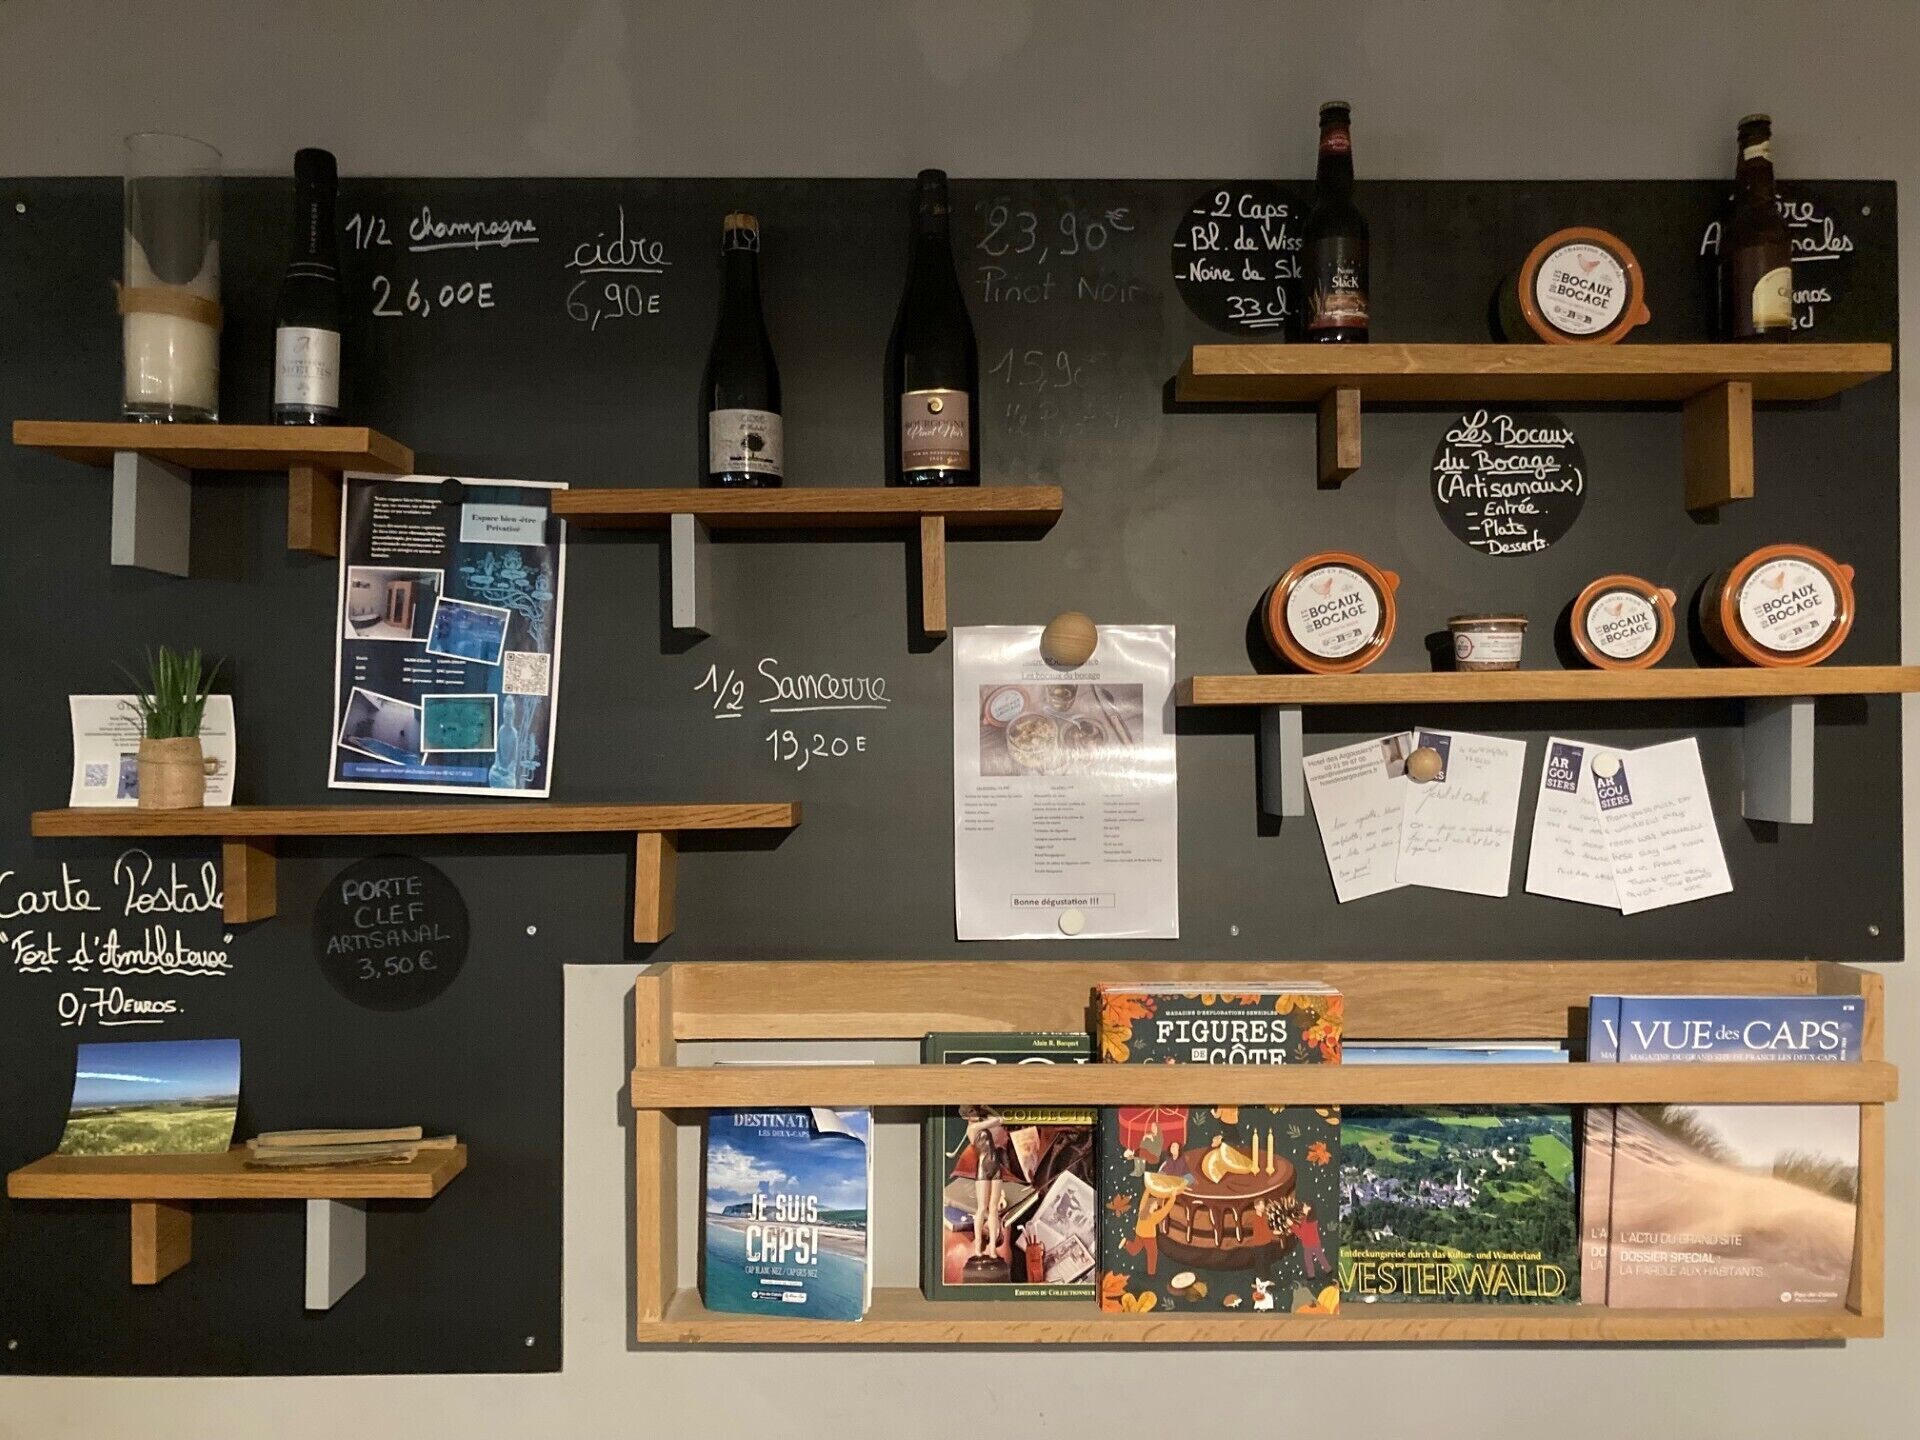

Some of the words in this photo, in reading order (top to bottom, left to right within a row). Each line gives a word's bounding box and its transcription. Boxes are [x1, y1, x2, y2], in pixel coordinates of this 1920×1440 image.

[345, 213, 393, 250] 1/2
[408, 206, 538, 250] champagne
[564, 204, 673, 270] cidre
[1233, 224, 1259, 251] de
[1260, 223, 1303, 251] Wiss
[1241, 258, 1266, 281] de
[976, 265, 1056, 303] Pinot
[1078, 276, 1143, 303] Noir
[1557, 284, 1610, 310] BOCAGE
[1561, 272, 1614, 299] BOCAUX
[1446, 409, 1492, 443] Les
[1491, 415, 1575, 446] Bocaux
[1433, 448, 1470, 471] du
[1309, 592, 1362, 618] BOCAUX
[1762, 583, 1817, 614] BOCAUX
[1767, 595, 1822, 625] BOCAGE
[1313, 604, 1367, 630] BOCAGE
[1602, 612, 1648, 634] BOCAUX
[1605, 621, 1652, 643] BOCAGE
[694, 664, 745, 711] 1/2
[757, 658, 892, 704] Sancerre
[1548, 768, 1573, 781] GOU
[1550, 756, 1569, 768] AR
[1546, 778, 1576, 791] SIERS
[1597, 777, 1614, 788] AR
[1599, 785, 1623, 799] GOU
[1601, 796, 1630, 809] SIERS
[341, 875, 423, 905] PORTE
[1014, 898, 1040, 906] Bonne
[1041, 897, 1088, 908] dégustation
[354, 902, 424, 929] CLEF
[326, 923, 451, 955] ARTISANAL
[1155, 1020, 1288, 1044] FIGURES
[1631, 1020, 1714, 1051] VUE
[1715, 1024, 1740, 1041] des
[1742, 1020, 1840, 1051] CAPS
[1193, 1049, 1207, 1060] DE
[748, 1193, 769, 1222] JE
[775, 1194, 818, 1223] SUIS
[746, 1225, 819, 1266] CAPS!
[1718, 1233, 1743, 1246] SITE
[1407, 1250, 1430, 1259] durch
[1432, 1251, 1446, 1259] das
[1476, 1252, 1492, 1260] und
[1492, 1252, 1542, 1261] Wanderland
[1620, 1252, 1668, 1264] DOSSIER
[1634, 1265, 1677, 1277] PAROLE
[1678, 1266, 1702, 1277] AUX
